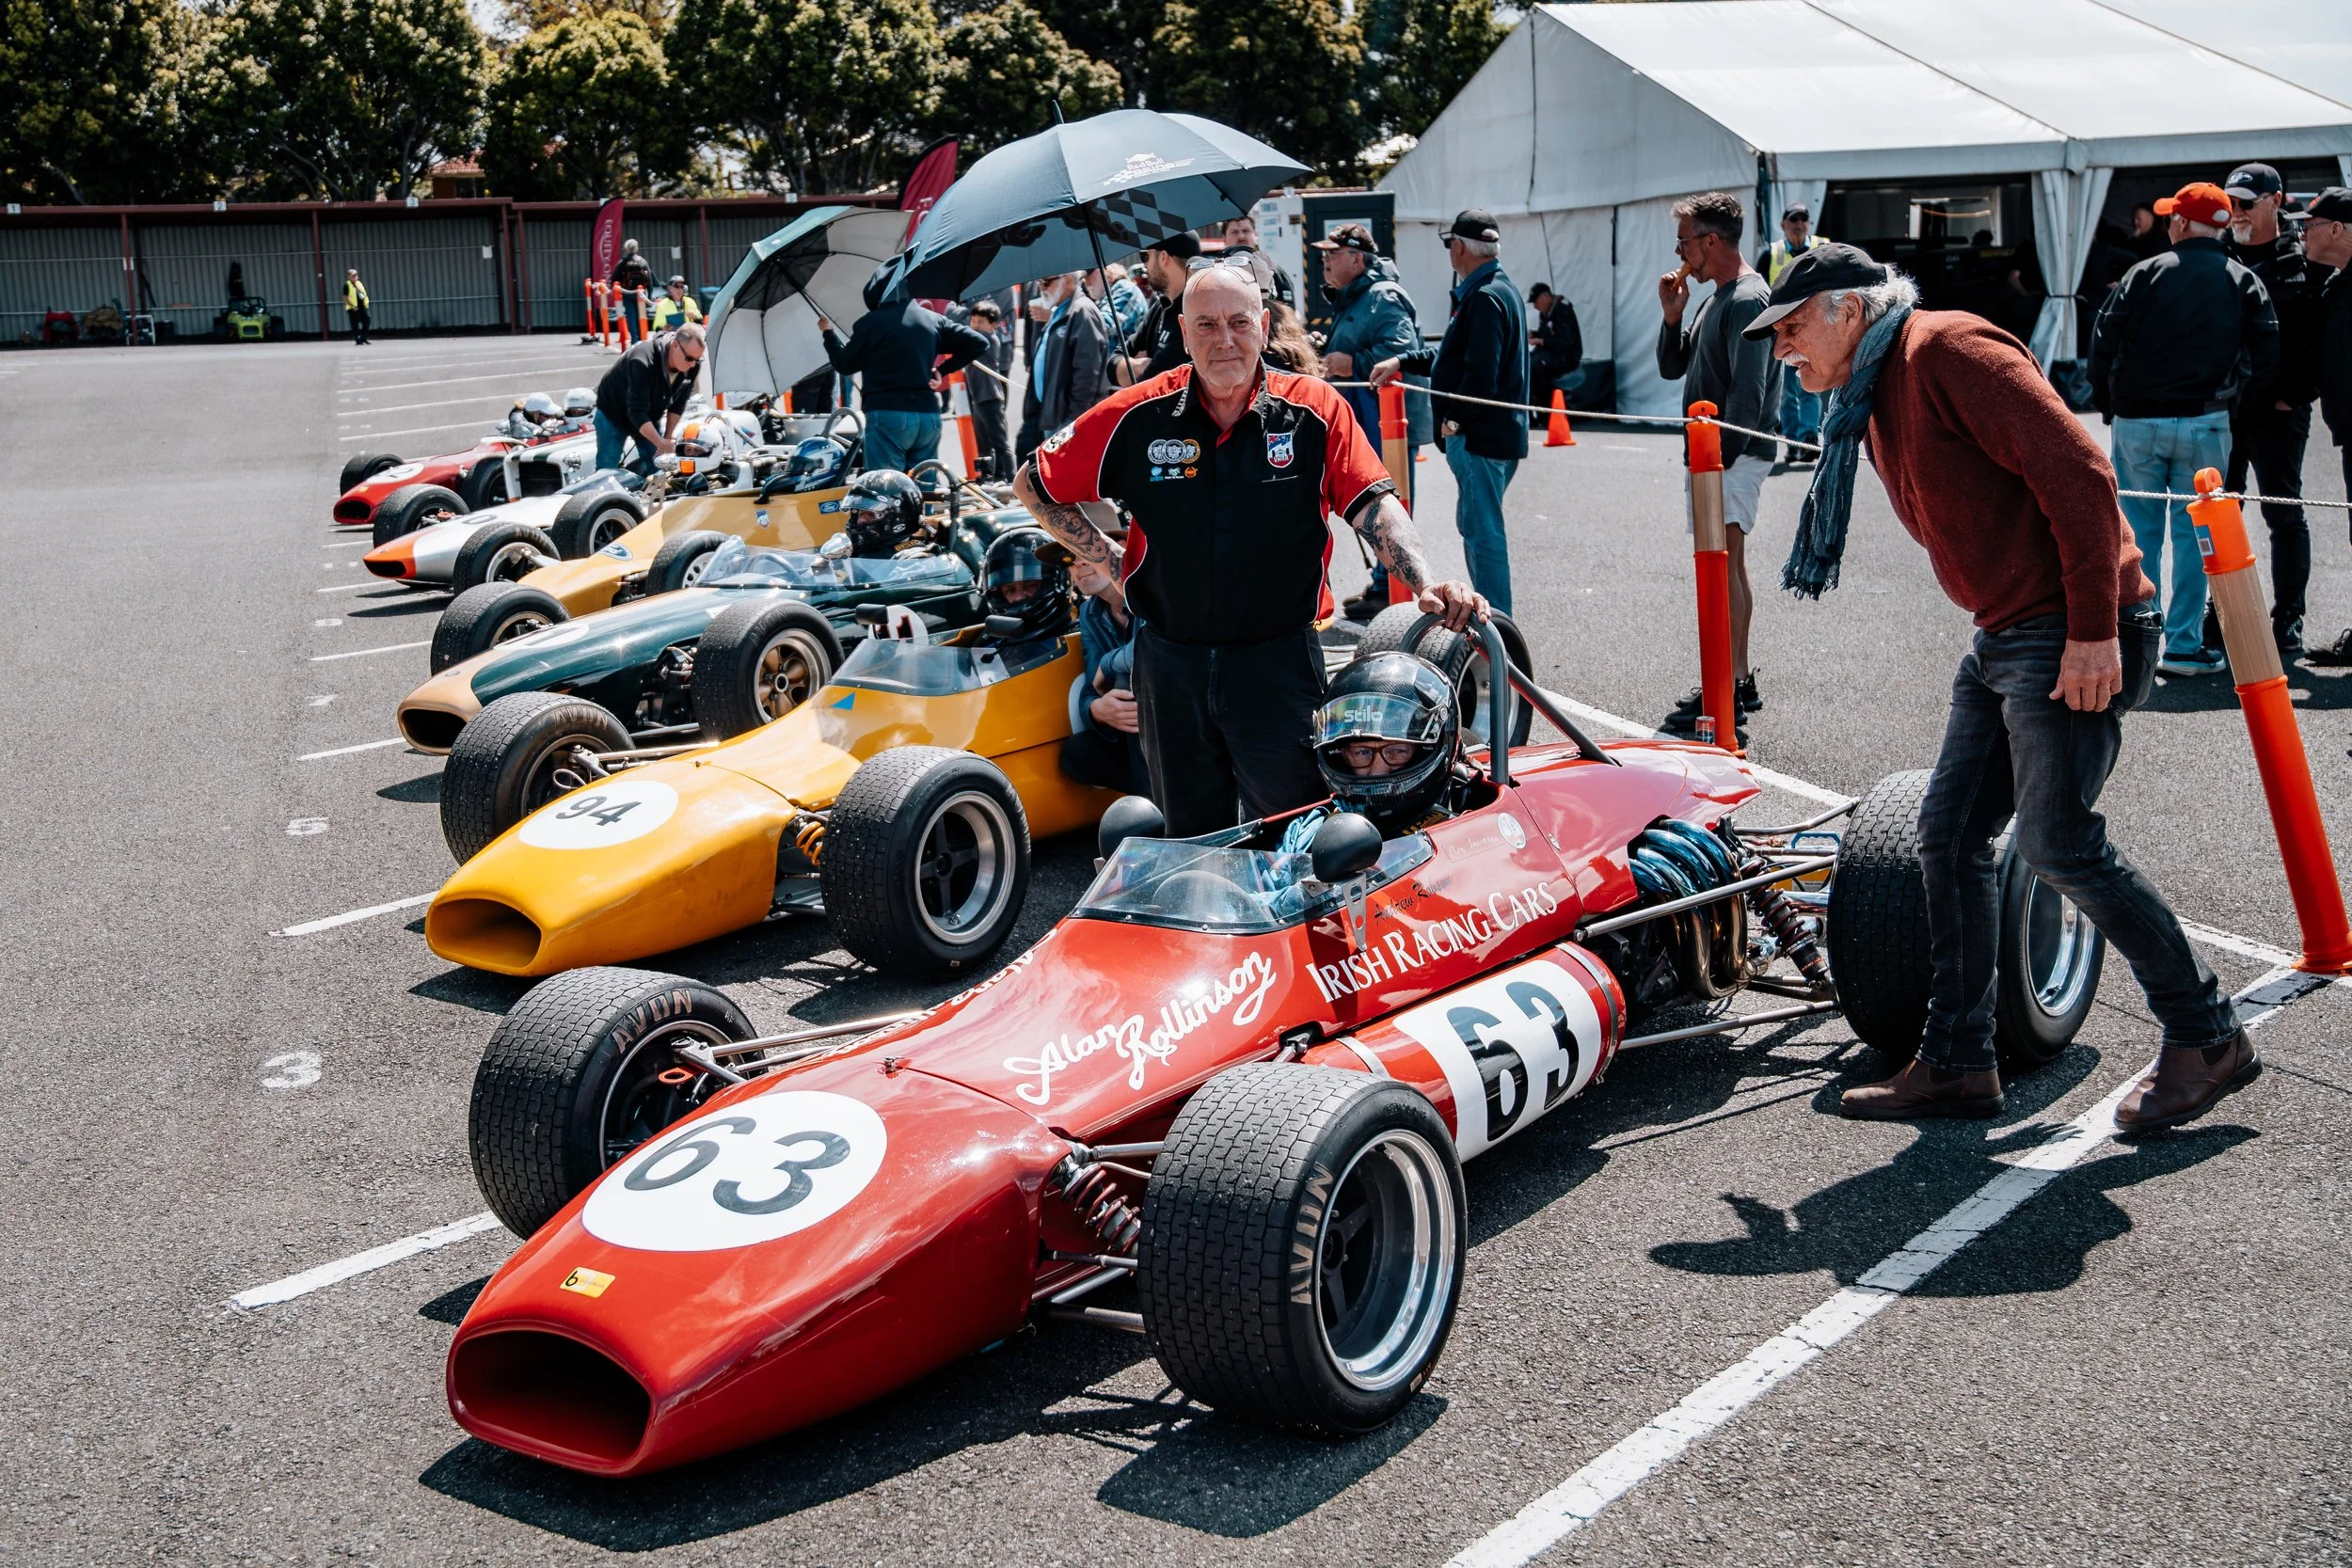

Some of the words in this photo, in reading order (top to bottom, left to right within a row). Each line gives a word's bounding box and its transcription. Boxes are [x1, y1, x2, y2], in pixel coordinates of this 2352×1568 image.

[555, 796, 643, 827] 94
[1305, 948, 1394, 1004] IRISH
[1383, 908, 1493, 974] RACING
[1487, 881, 1558, 931] CARS
[262, 1051, 322, 1090] 3
[612, 989, 692, 1054] AVON
[1003, 1023, 1118, 1106] Alan
[1115, 951, 1277, 1091] Rollinson
[1446, 981, 1580, 1142] 63
[624, 1117, 851, 1215] 63
[1290, 1161, 1334, 1305] AVON
